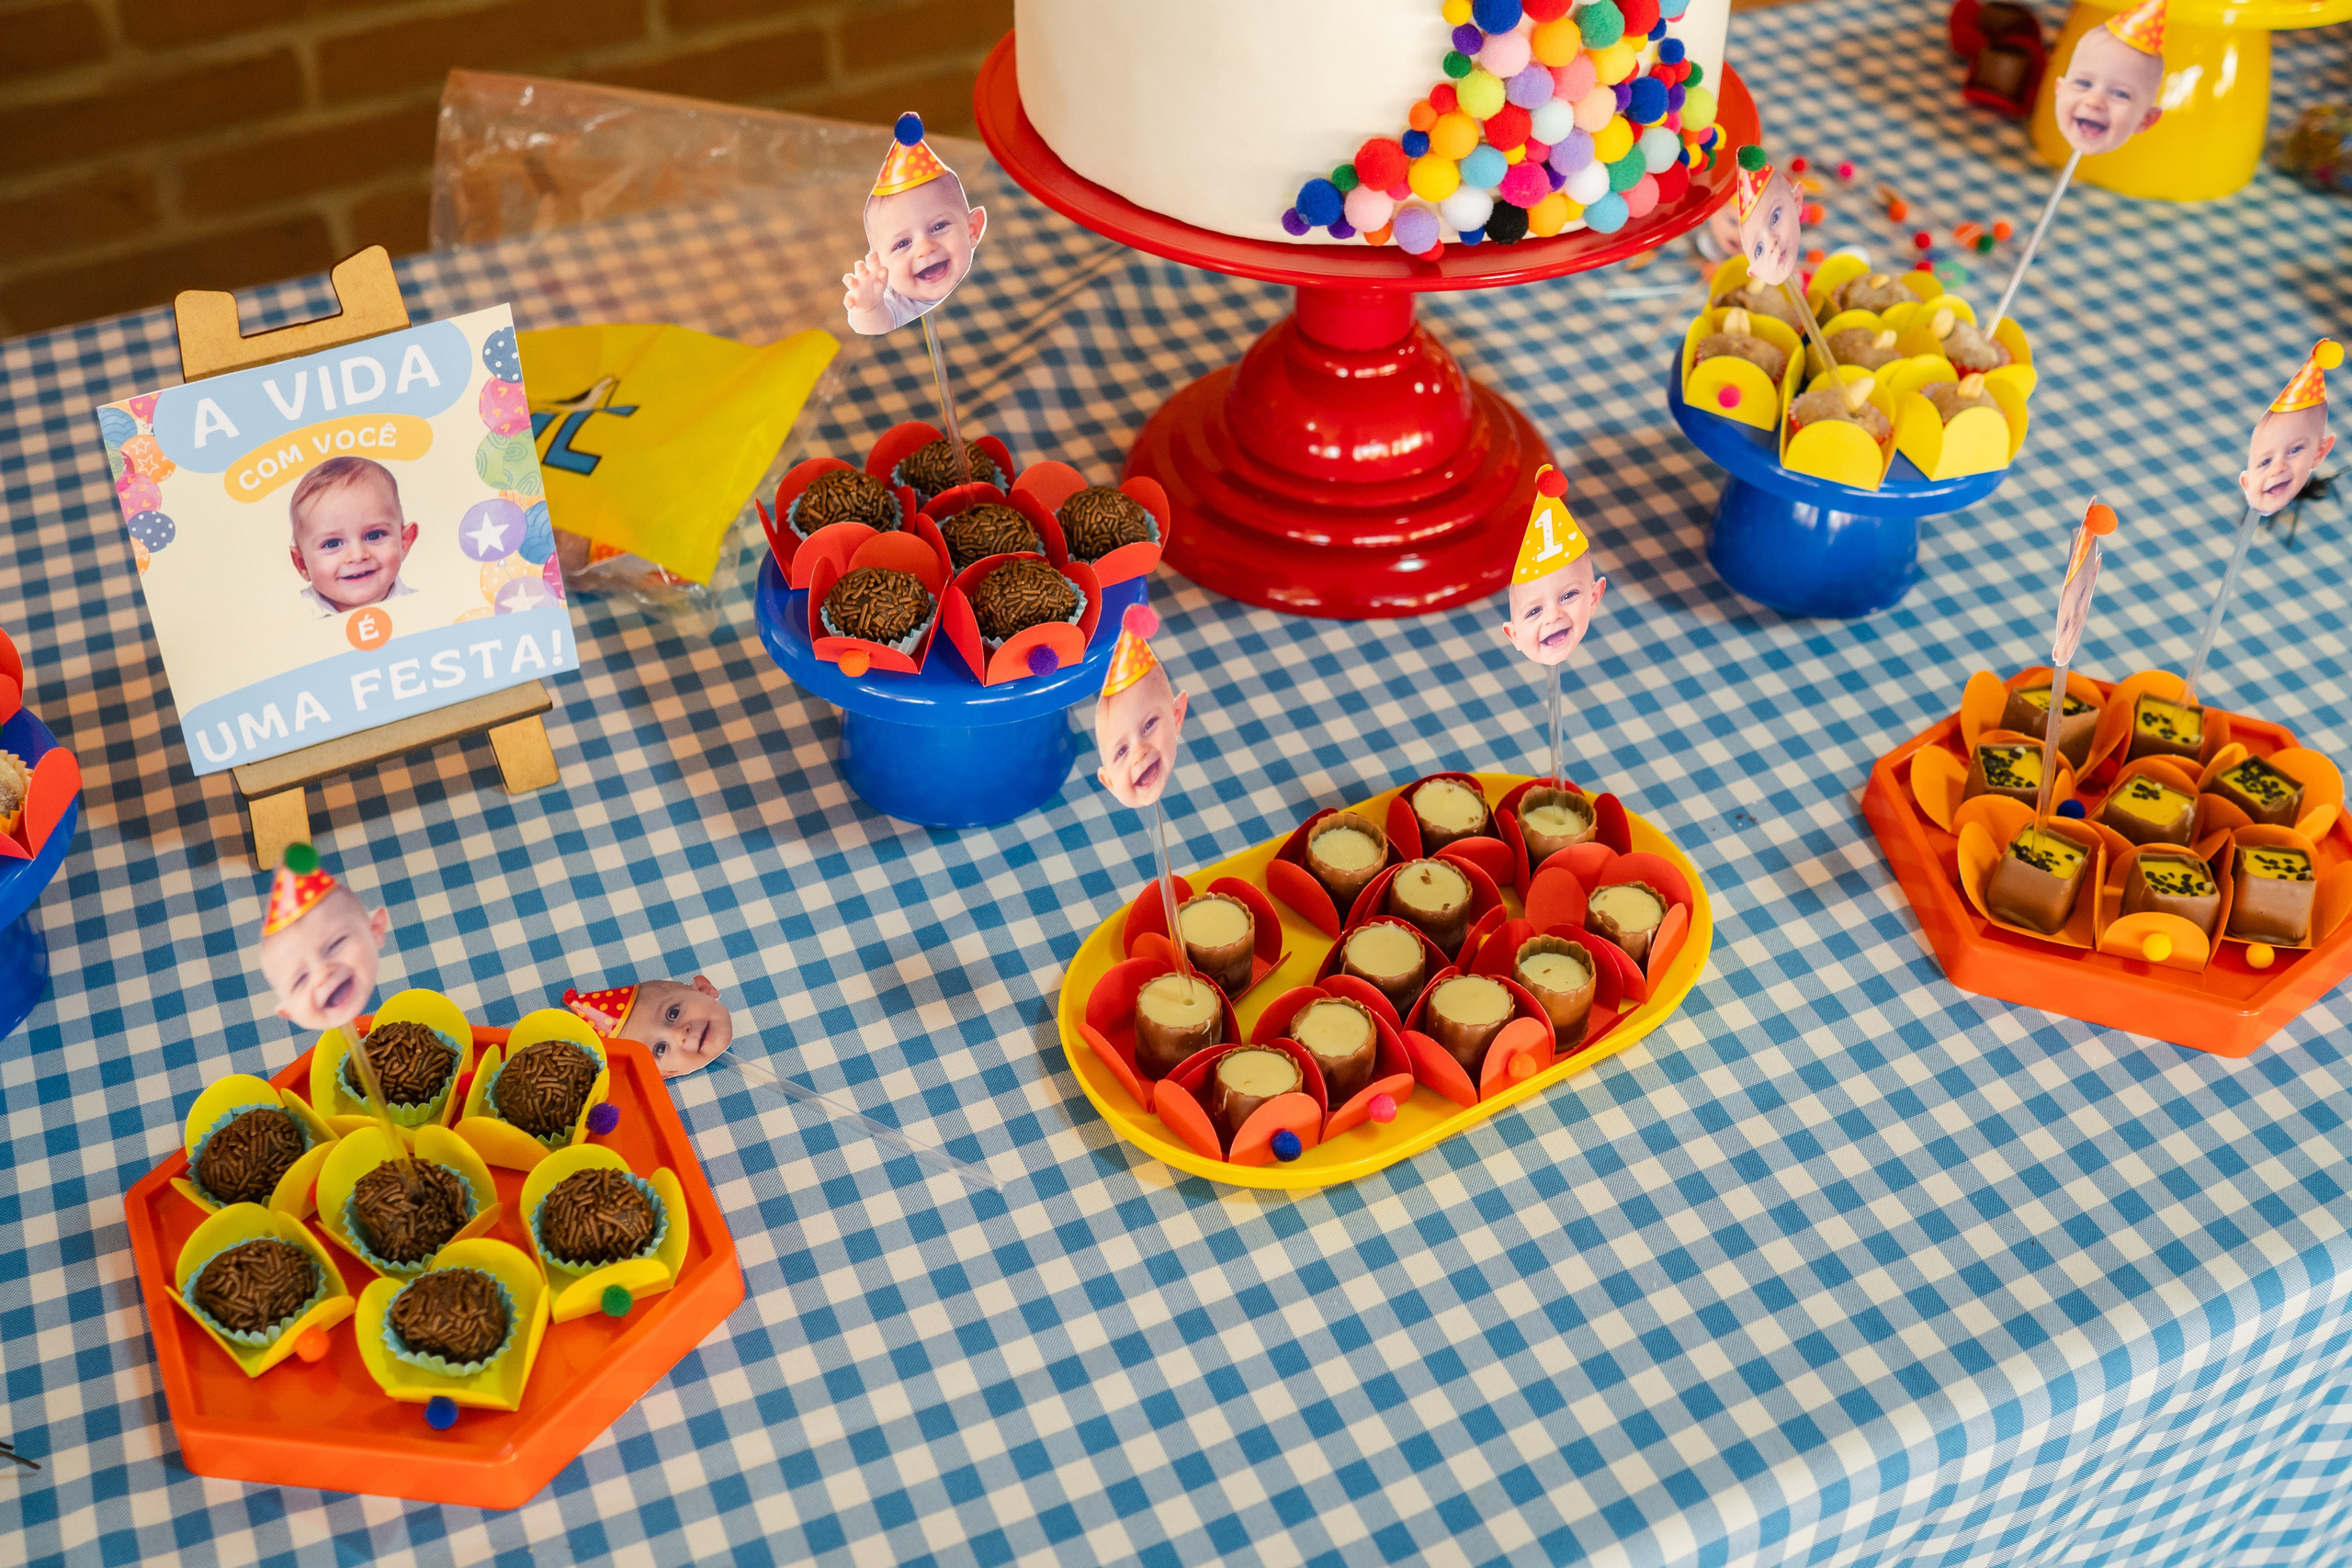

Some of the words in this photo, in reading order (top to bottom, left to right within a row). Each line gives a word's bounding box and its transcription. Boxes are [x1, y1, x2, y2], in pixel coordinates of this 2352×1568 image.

[194, 398, 240, 449] A
[264, 344, 441, 421] VIDA
[238, 444, 304, 491] COM
[312, 423, 398, 454] VOCÊ
[1534, 508, 1563, 563] 1
[357, 613, 379, 641] É
[196, 690, 332, 763] UMA
[350, 629, 563, 711] FESTA!
